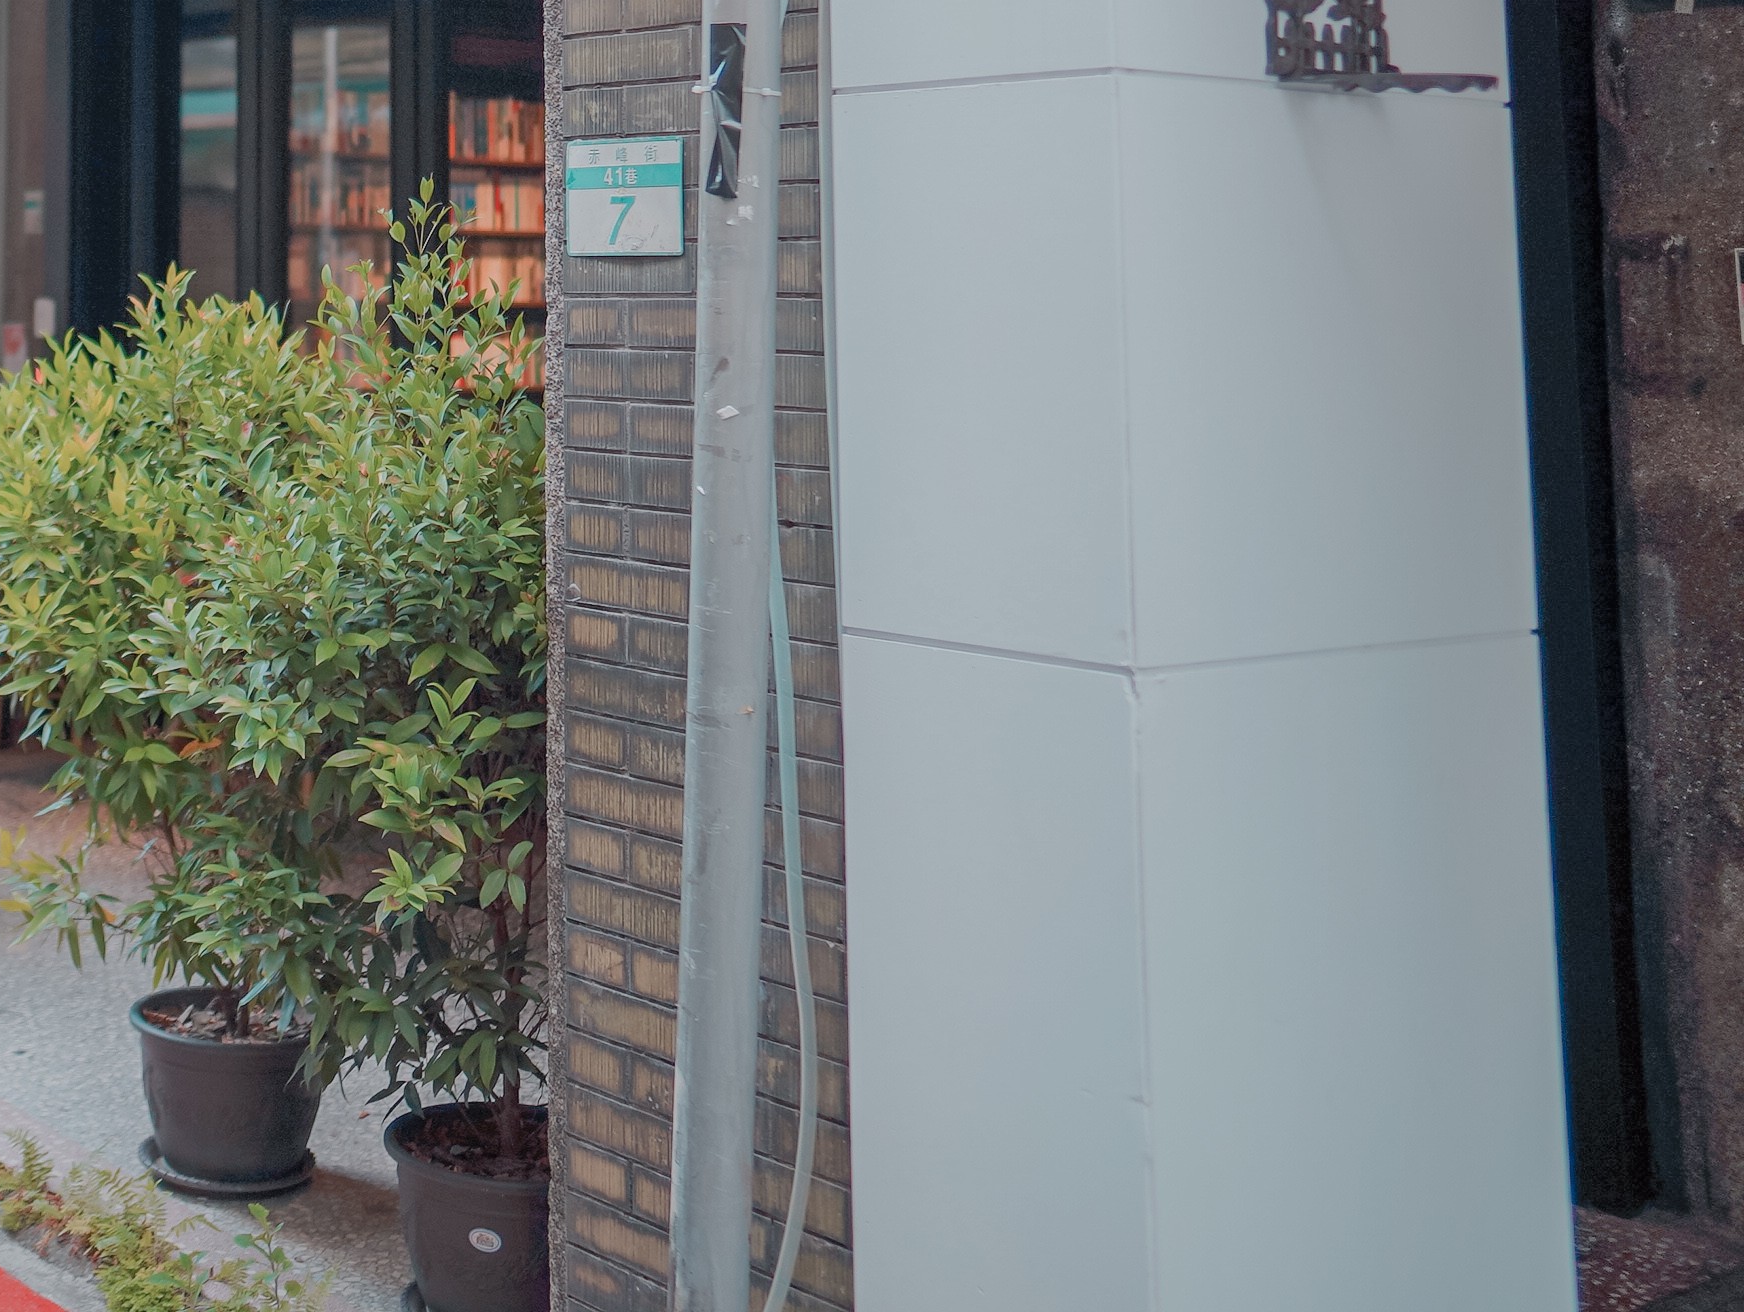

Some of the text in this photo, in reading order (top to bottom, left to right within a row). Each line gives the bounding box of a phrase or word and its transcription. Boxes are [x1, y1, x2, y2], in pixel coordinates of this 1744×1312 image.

[588, 145, 658, 164] 赤峰街
[603, 168, 638, 185] 41巷
[609, 196, 635, 244] 7
